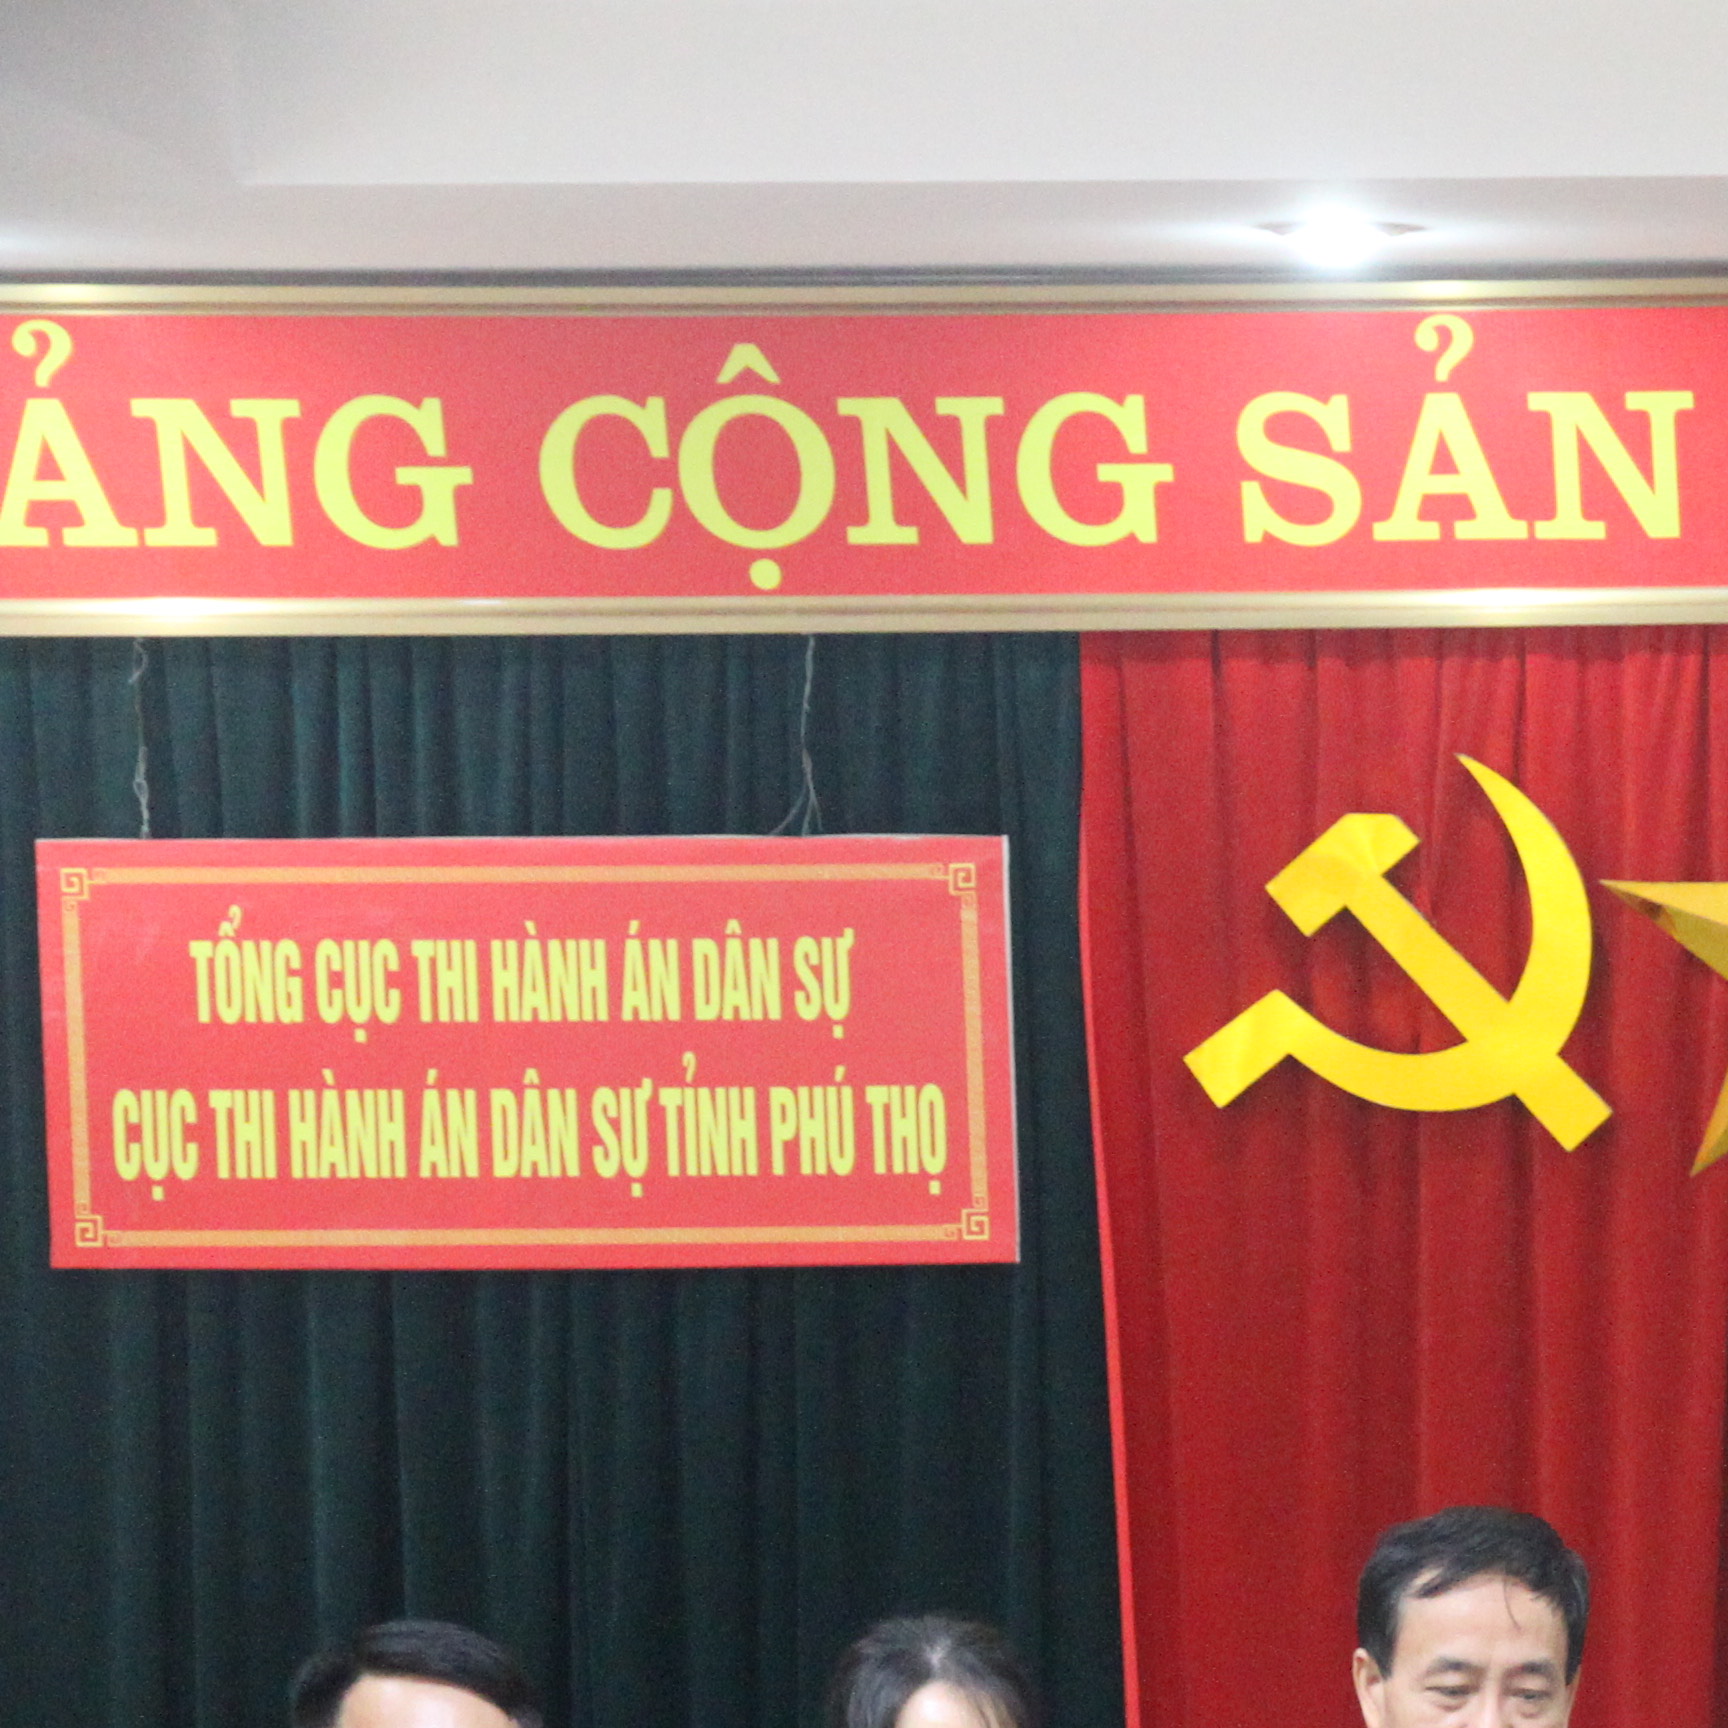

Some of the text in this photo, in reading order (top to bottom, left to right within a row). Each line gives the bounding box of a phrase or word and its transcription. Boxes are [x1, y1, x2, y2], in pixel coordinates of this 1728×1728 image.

[0, 319, 473, 551] ẢNG
[538, 343, 1175, 591] CỘNG
[1235, 313, 1695, 547] SẢN
[189, 905, 854, 1042] TỔNG CỤC THI HÀNH ÁN DÂN SỰ
[113, 1052, 947, 1200] CỤC THI HÀNH ÁN DÂN SỰ TỈNH PHÚ THỌ
